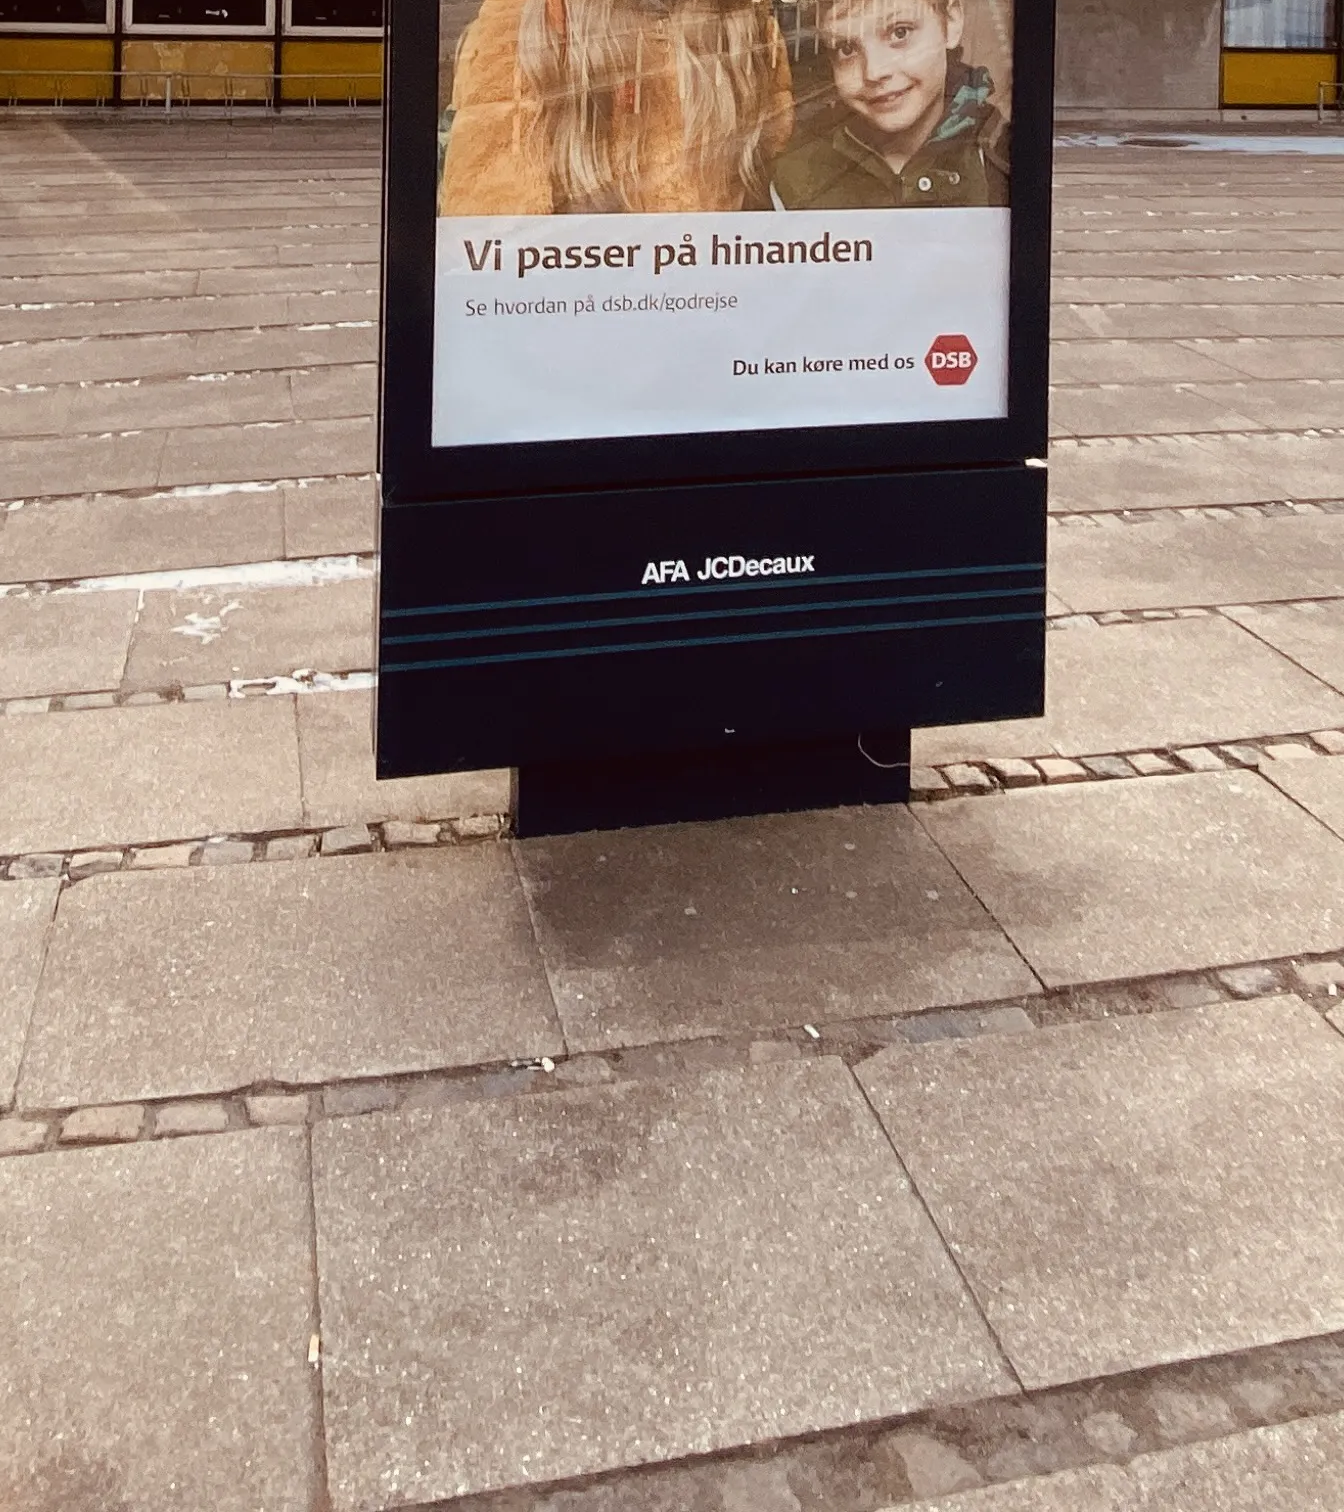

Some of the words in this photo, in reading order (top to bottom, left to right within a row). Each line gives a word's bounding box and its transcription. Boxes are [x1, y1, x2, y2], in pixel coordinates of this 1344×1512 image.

[463, 238, 503, 272] Vi
[517, 245, 642, 278] passer
[653, 233, 697, 275] på
[711, 232, 874, 266] hinanden
[465, 299, 488, 317] Se
[494, 296, 568, 316] hvordan
[574, 294, 596, 317] på
[602, 292, 739, 314] dsb.dk/godrejse
[732, 359, 759, 377] Du
[764, 356, 798, 375] kan
[802, 355, 843, 375] køre
[848, 354, 889, 372] med
[893, 356, 915, 370] os
[930, 351, 972, 370] DSB
[641, 560, 690, 585] AFA
[697, 554, 816, 581] JCDecaux
